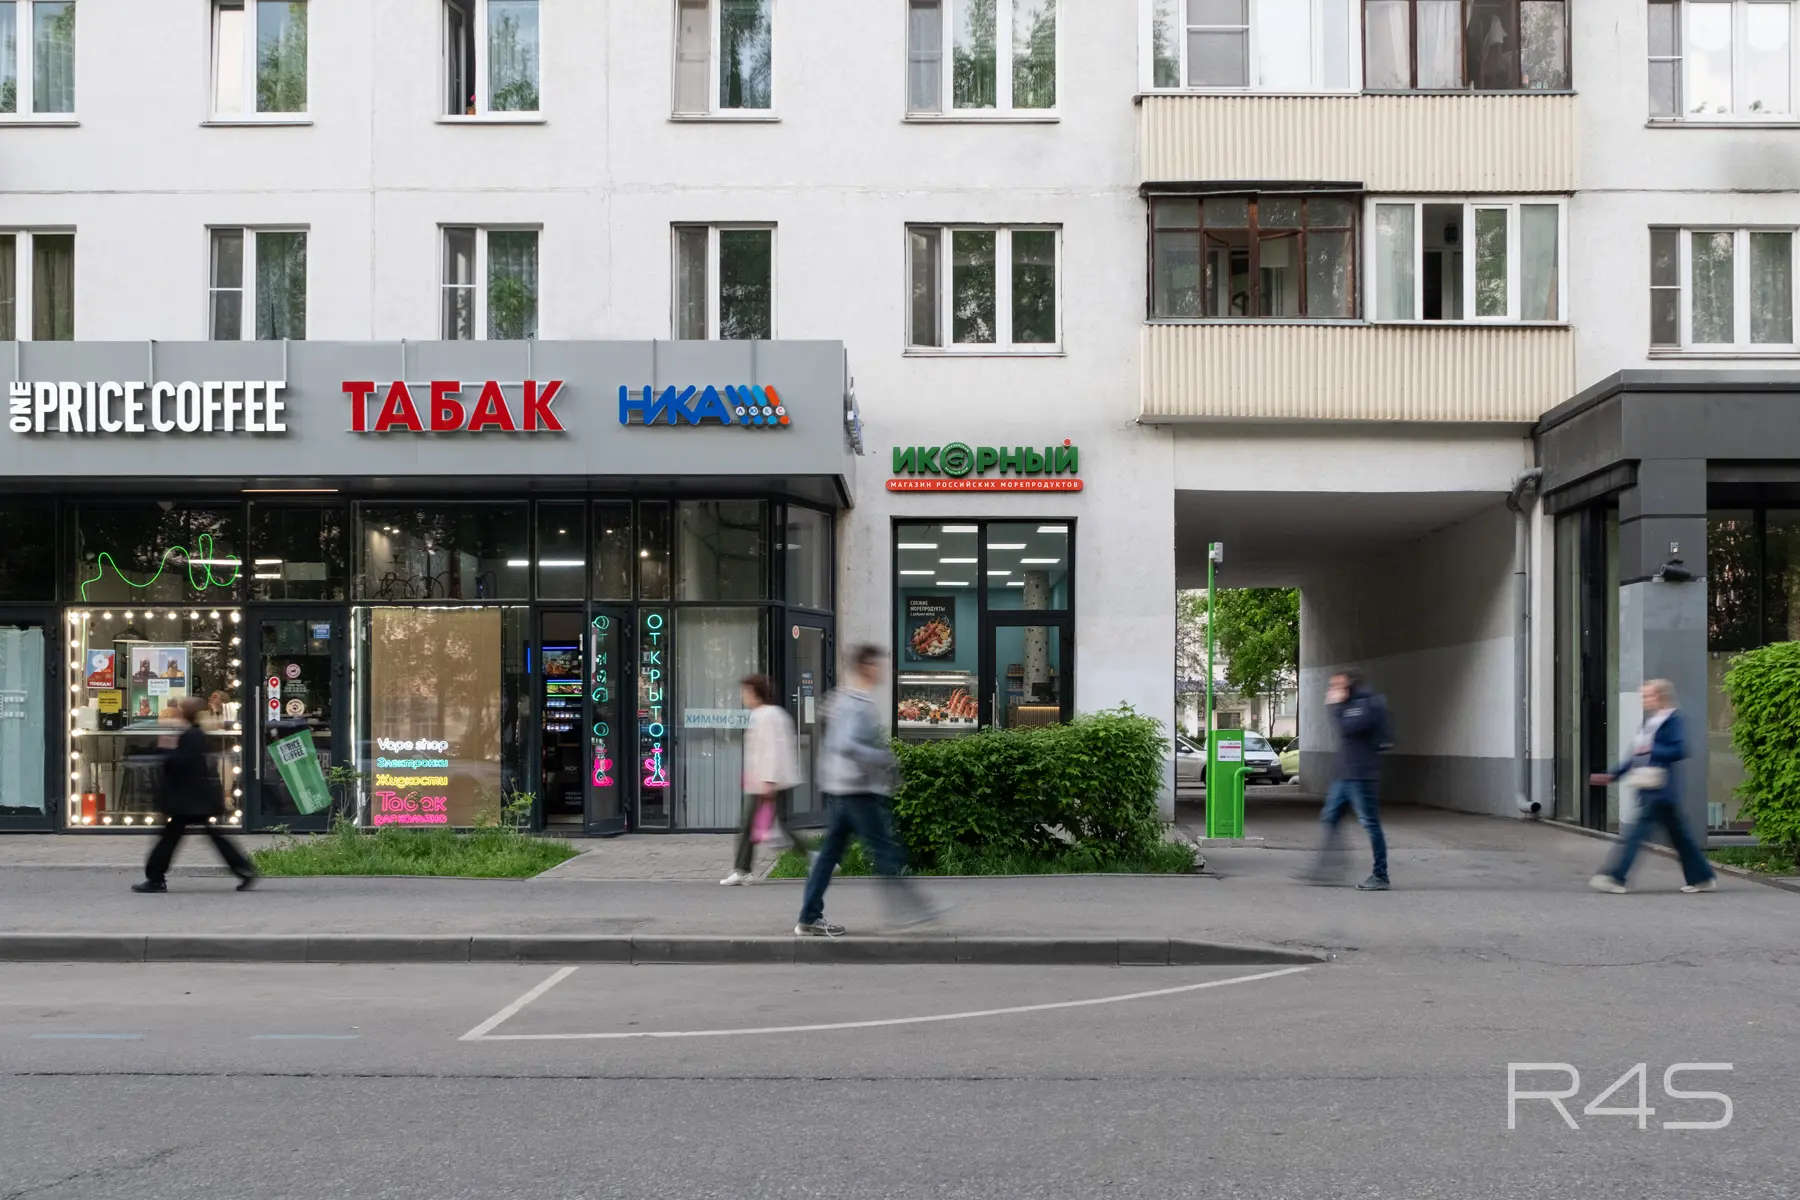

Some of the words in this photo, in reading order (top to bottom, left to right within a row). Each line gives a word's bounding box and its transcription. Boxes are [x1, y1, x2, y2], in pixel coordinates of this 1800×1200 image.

[9, 381, 31, 433] ONE
[35, 381, 145, 433] PRICE
[152, 381, 287, 432] COFFEE
[342, 380, 566, 431] ТАБАК
[619, 385, 732, 425] НИКА
[893, 438, 1079, 476] ИКОРНЫЙ
[936, 480, 996, 488] РОССИЙСКИХ
[647, 614, 664, 737] ОТКРЫТО
[376, 737, 414, 753] Vape
[415, 737, 449, 753] shop
[375, 773, 449, 789] Жидкости
